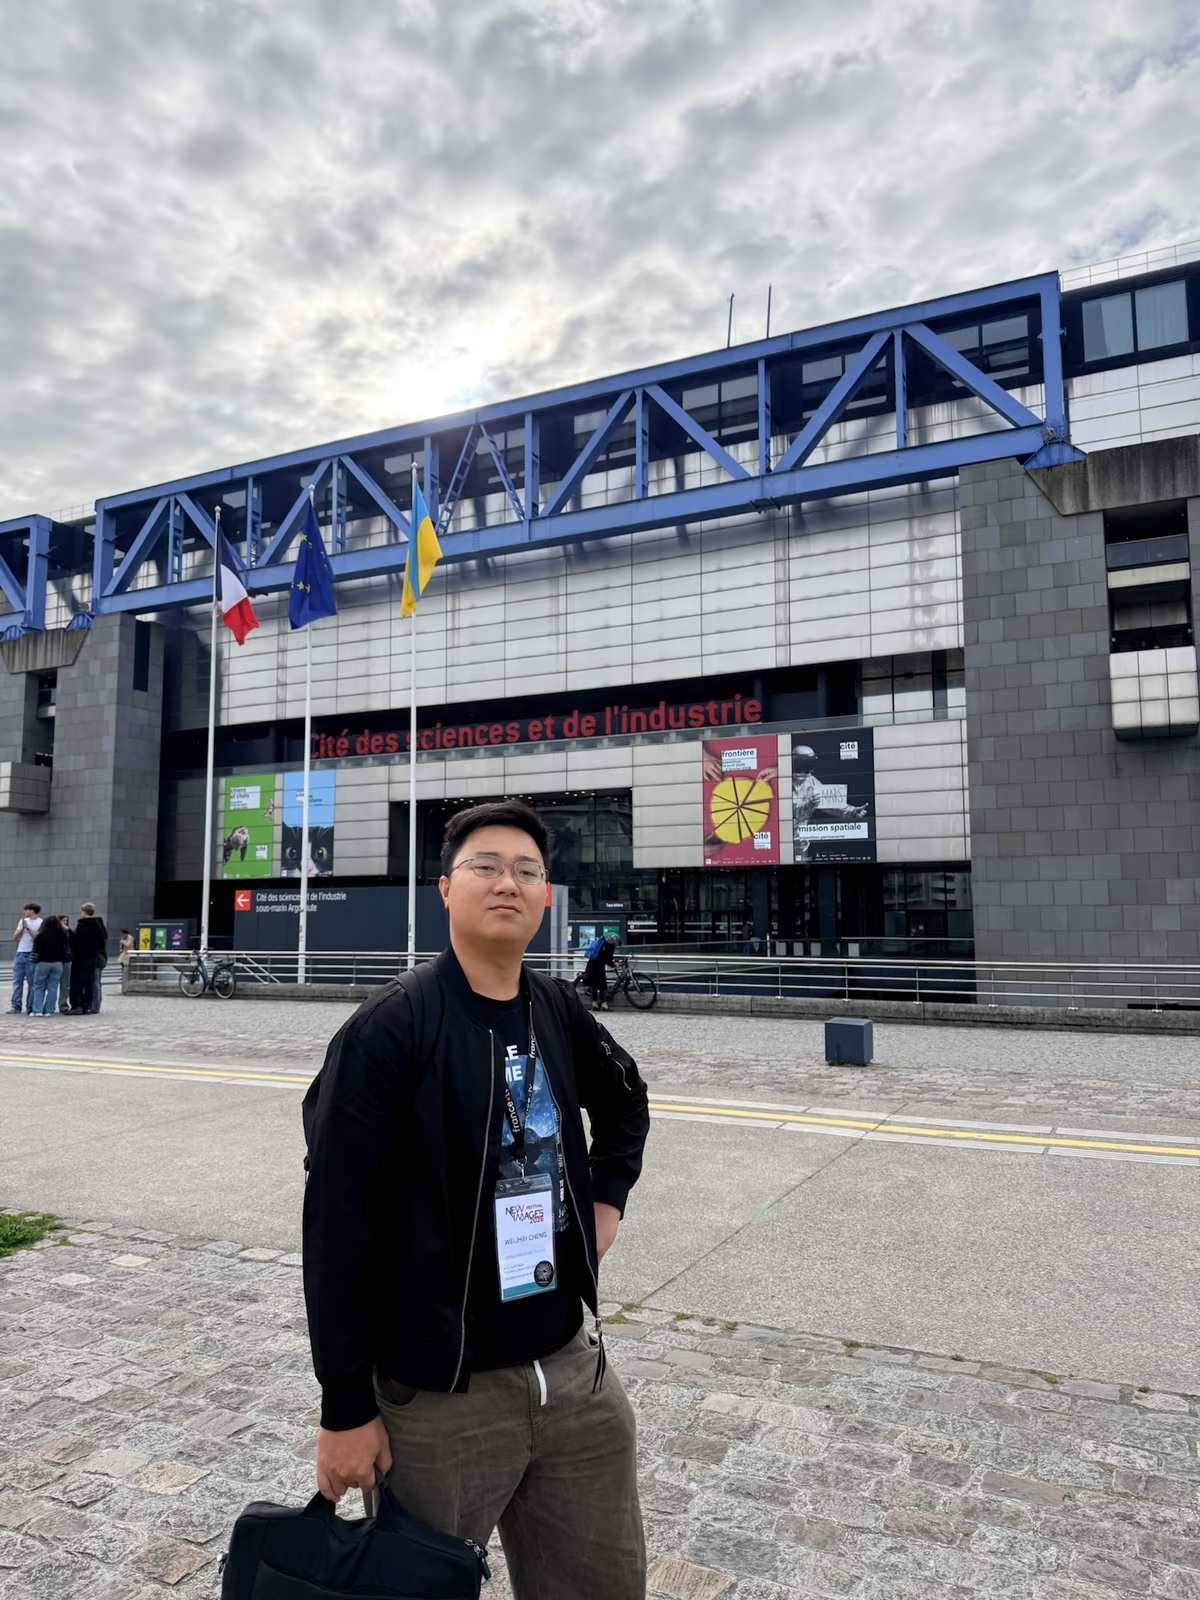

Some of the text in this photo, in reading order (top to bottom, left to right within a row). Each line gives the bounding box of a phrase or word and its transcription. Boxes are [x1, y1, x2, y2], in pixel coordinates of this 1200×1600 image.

[355, 729, 399, 755] des
[527, 714, 556, 741] et
[562, 709, 597, 738] de
[604, 693, 762, 735] l'industrie
[839, 742, 856, 750] cité
[721, 749, 755, 758] frontière
[798, 822, 862, 833] mission spatiale
[754, 832, 769, 840] cité
[256, 892, 267, 902] Cité
[267, 892, 278, 902] des
[310, 892, 318, 901] de
[255, 904, 287, 913] sous-marin
[505, 1204, 525, 1216] NEW
